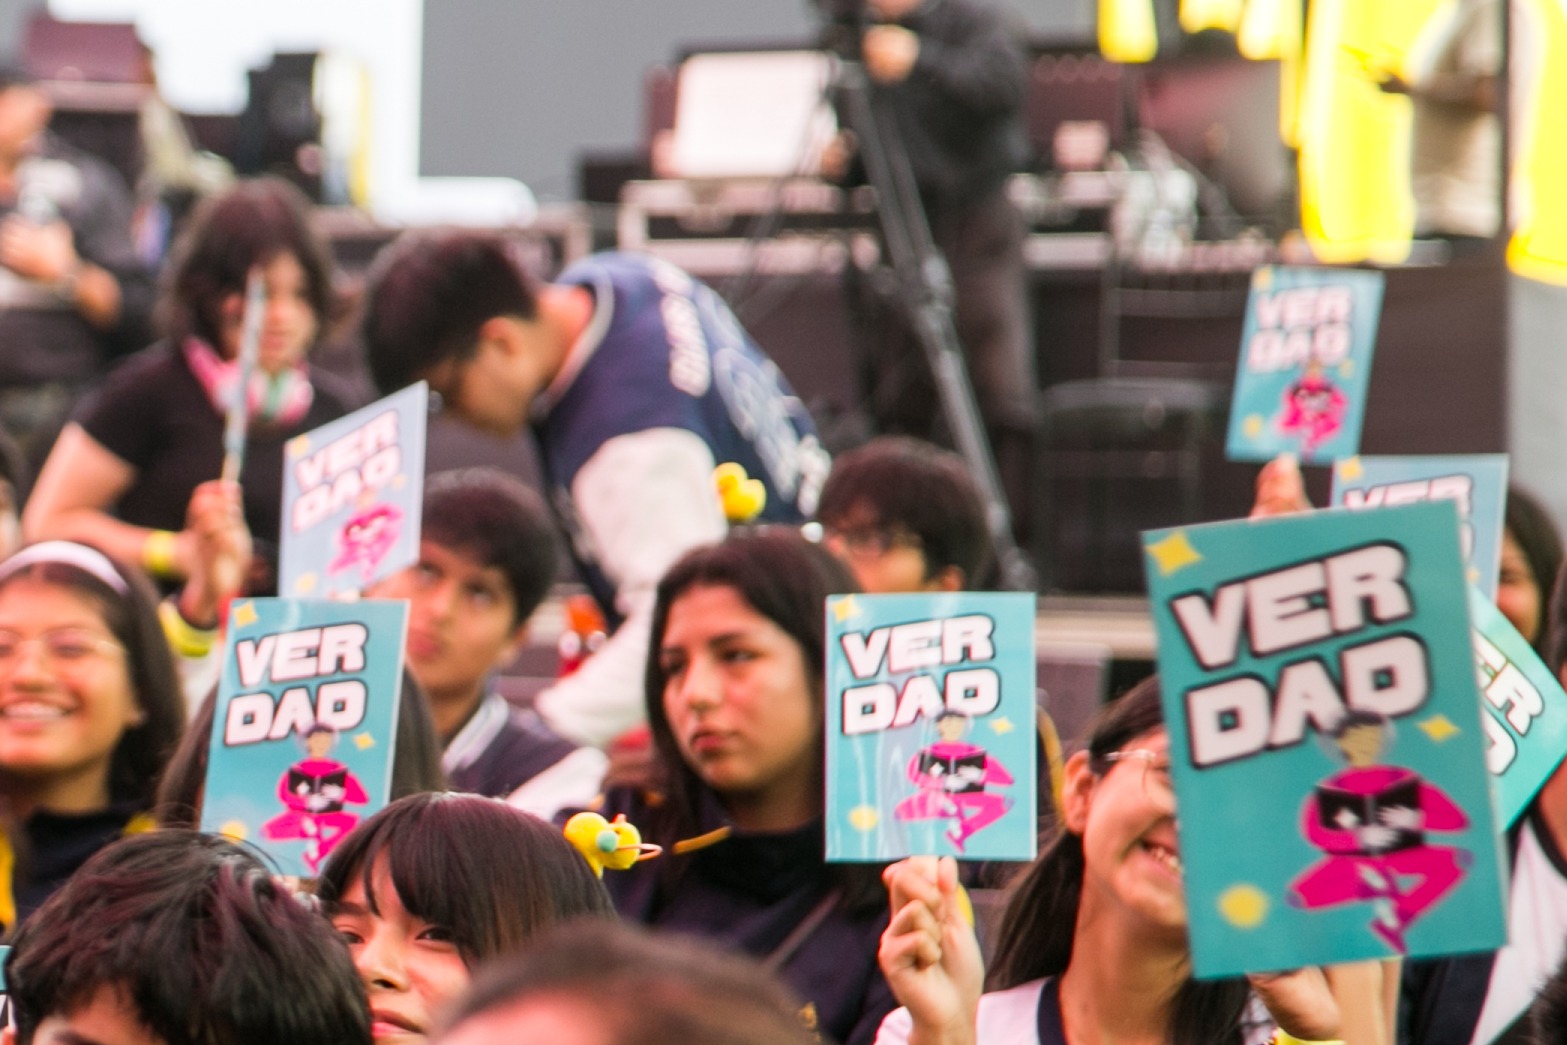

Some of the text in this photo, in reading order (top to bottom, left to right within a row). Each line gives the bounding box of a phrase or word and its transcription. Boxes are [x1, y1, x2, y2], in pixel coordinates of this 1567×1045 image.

[1256, 284, 1354, 330] VER
[1246, 321, 1352, 374] DAD
[295, 409, 400, 493] VER
[291, 443, 401, 533] DAD
[1169, 538, 1417, 672] VER
[235, 620, 370, 688] VER
[838, 613, 997, 680] VER
[1470, 622, 1547, 738] ER
[224, 677, 369, 747] DAD
[841, 666, 1002, 736] DAD
[1184, 630, 1431, 770] DAD
